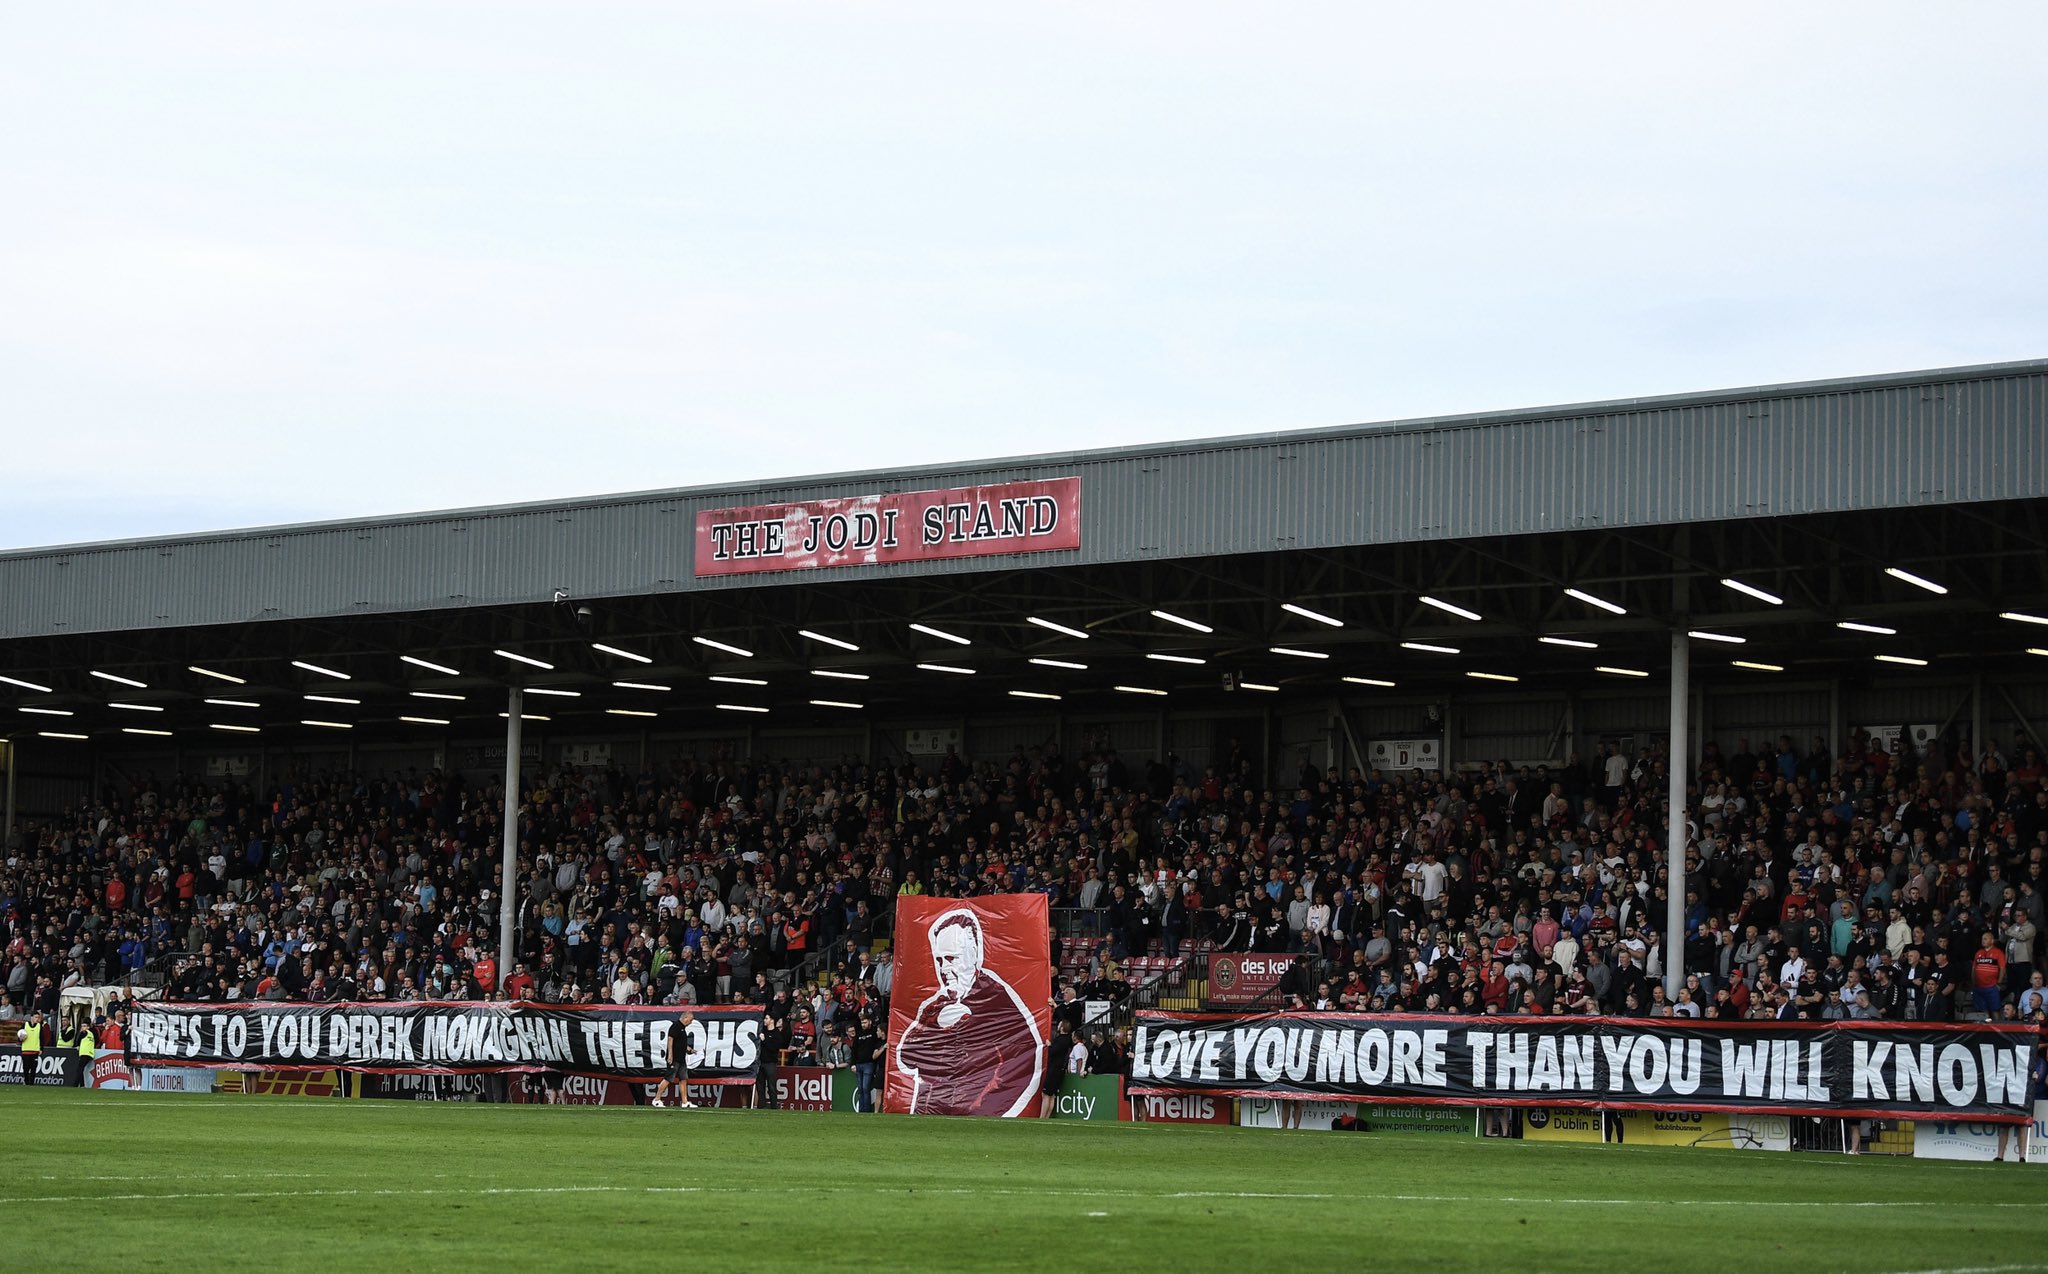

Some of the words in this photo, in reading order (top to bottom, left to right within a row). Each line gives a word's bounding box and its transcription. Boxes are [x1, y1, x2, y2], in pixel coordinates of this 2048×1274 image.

[711, 518, 785, 560] THE
[803, 508, 898, 552] JODI
[922, 495, 1059, 545] STAND
[1400, 751, 1408, 765] D
[1241, 958, 1265, 975] des
[1269, 959, 1296, 975] kel
[131, 1012, 202, 1057] HERE'S
[212, 1014, 247, 1058] TO
[261, 1014, 320, 1059] YOU
[329, 1014, 415, 1061] DEREK
[422, 1014, 574, 1063] MONAGHAN
[580, 1020, 645, 1068] THE
[650, 1019, 759, 1069] BOHS
[1132, 1025, 1227, 1080] LOVE
[1234, 1026, 1315, 1083] YOU
[1315, 1028, 1448, 1087] MORE
[1466, 1031, 1595, 1091] THAN
[1600, 1034, 1702, 1094] YOU
[1720, 1038, 1830, 1102] WILL
[1853, 1040, 2031, 1107] KNOW
[34, 1076, 64, 1085] motion
[151, 1075, 185, 1091] NAUTICAL
[795, 1073, 833, 1101] kell
[563, 1075, 608, 1106] kelly
[1146, 1095, 1215, 1120] neills
[1372, 1107, 1384, 1117] all
[1386, 1107, 1422, 1118] retrofit
[1425, 1108, 1461, 1120] grants.
[1372, 1122, 1470, 1133] www.premierproperty.ie
[1554, 1118, 1589, 1131] Dublin
[1654, 1124, 1702, 1132] @dublinbusnews
